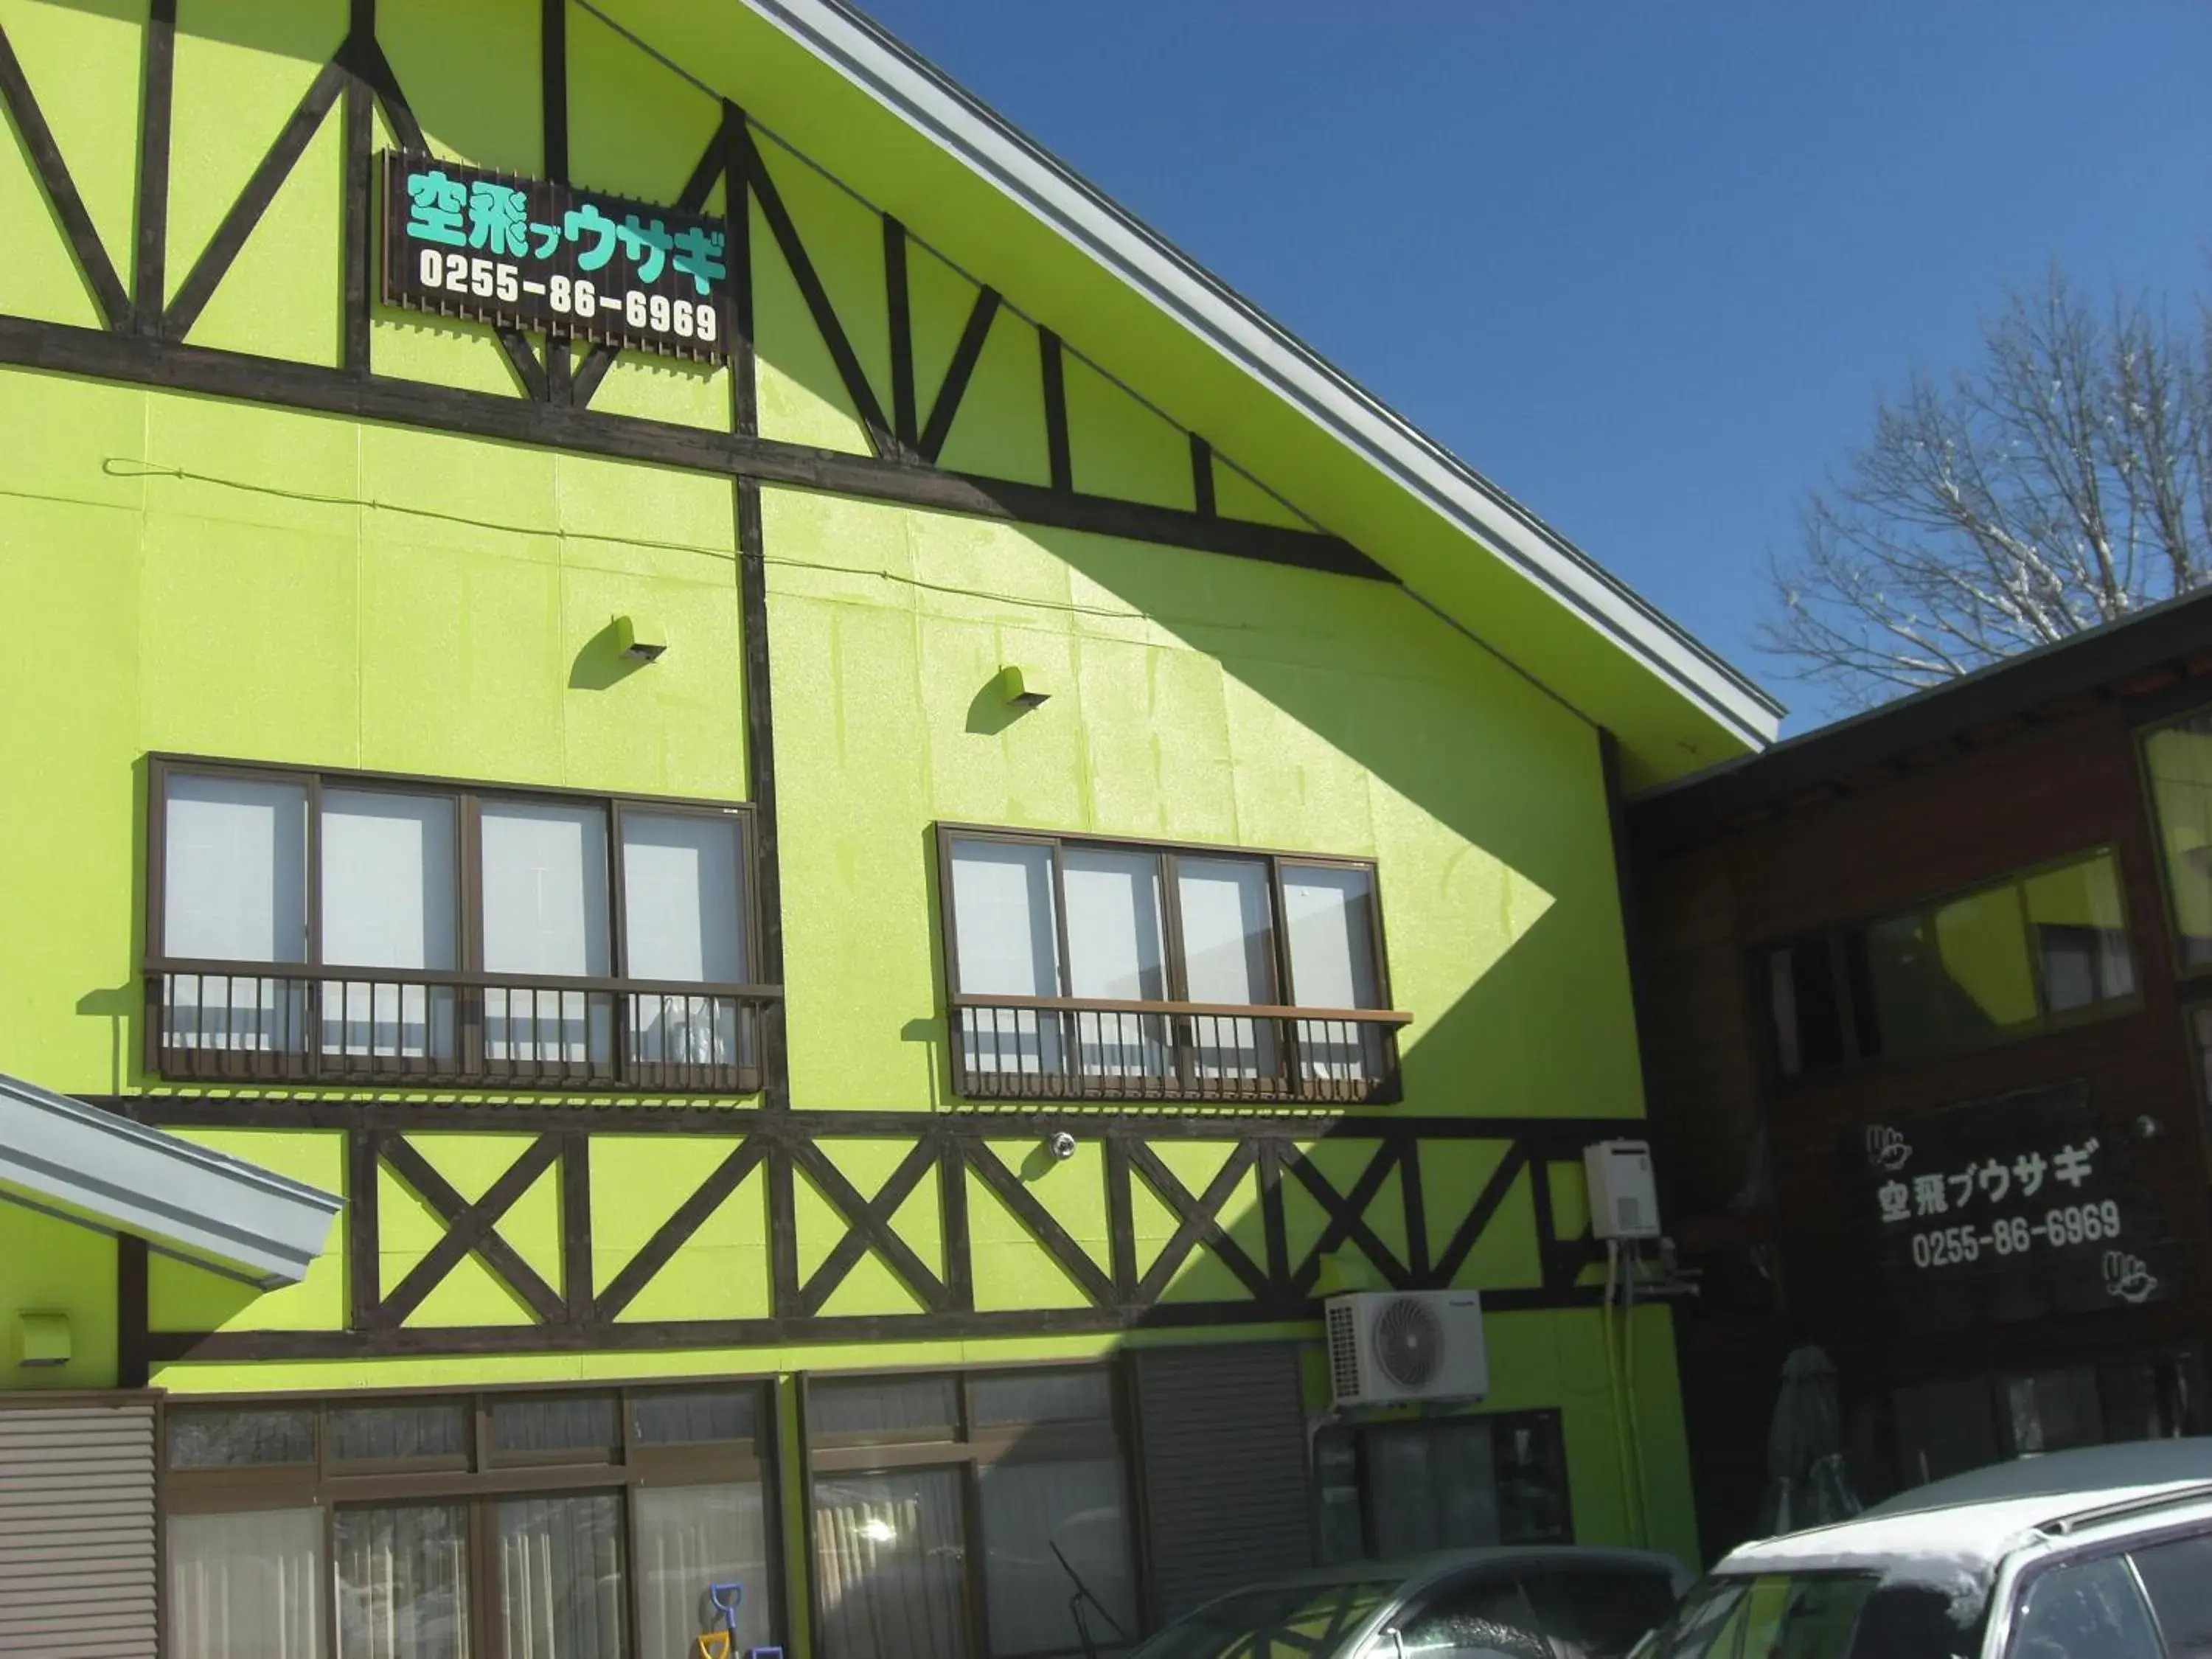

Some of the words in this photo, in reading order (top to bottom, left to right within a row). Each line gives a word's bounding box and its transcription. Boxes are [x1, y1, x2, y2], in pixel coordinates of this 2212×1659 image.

[1877, 1136, 2100, 1222] 空飛ブウサギ
